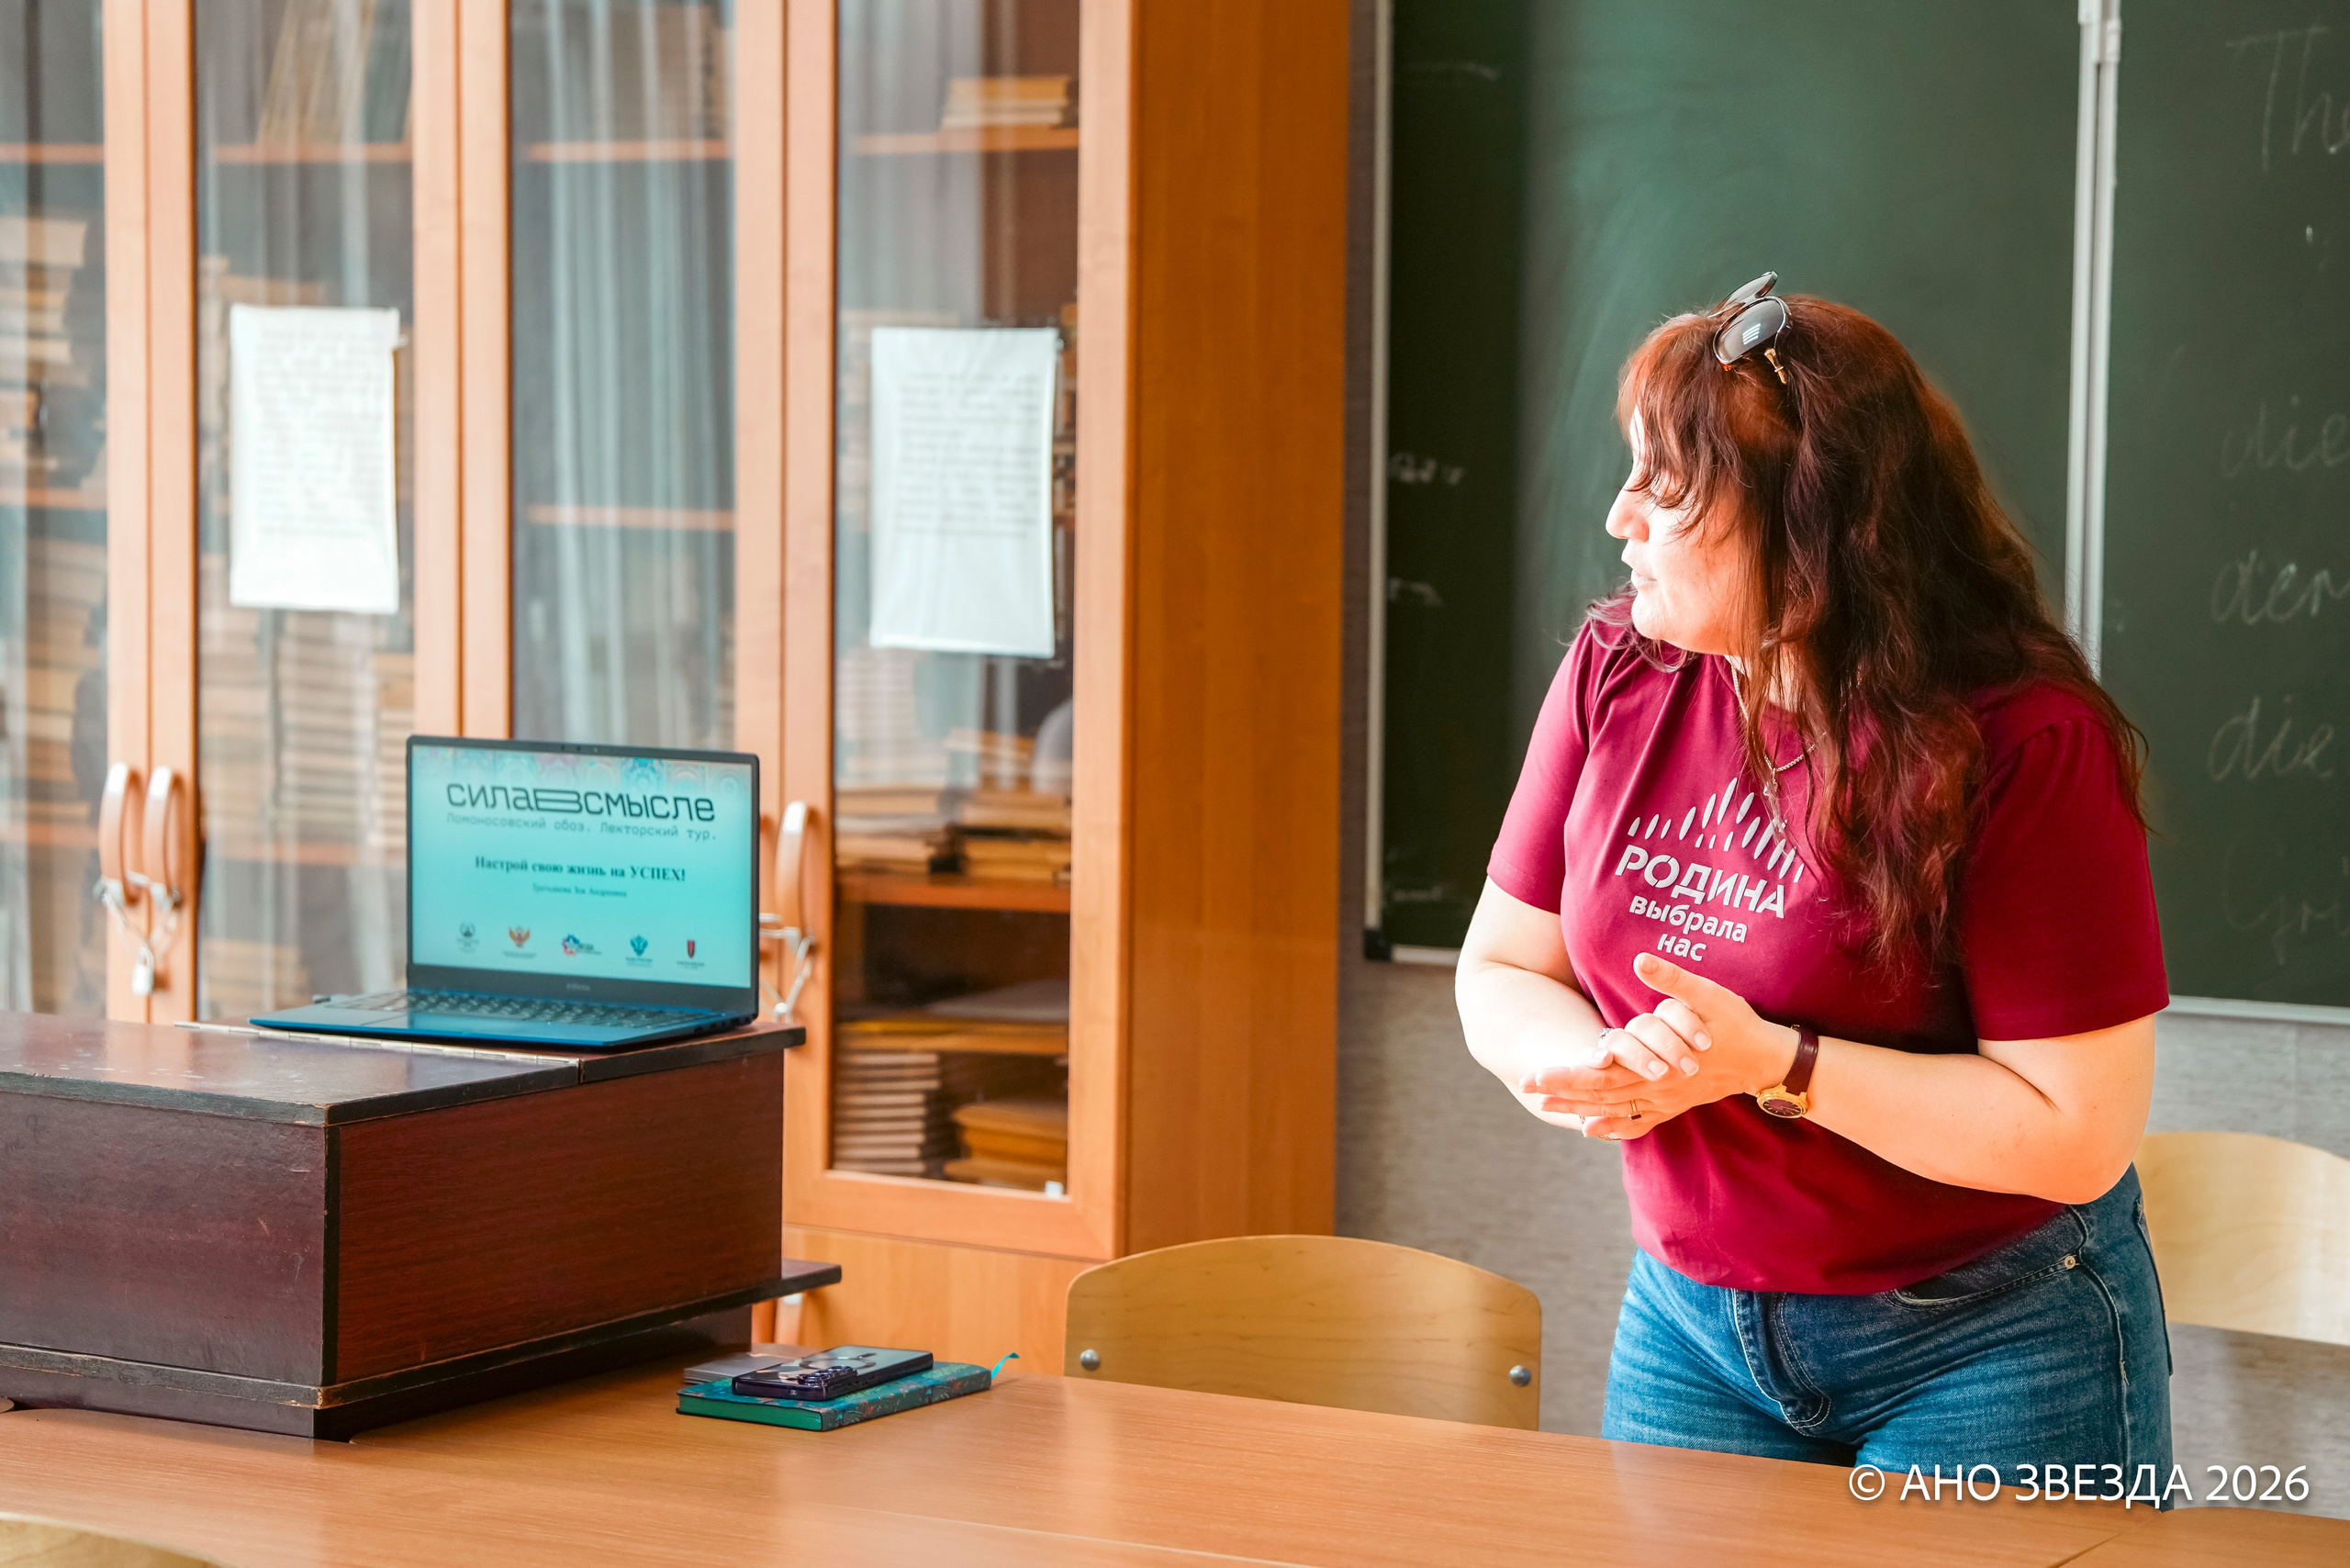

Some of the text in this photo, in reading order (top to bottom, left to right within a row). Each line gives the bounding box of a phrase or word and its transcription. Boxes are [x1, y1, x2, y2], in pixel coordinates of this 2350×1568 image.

[687, 828, 717, 842] тур.
[475, 855, 686, 882] Настрой свою жизнь на УСПЕХ!
[1615, 844, 1785, 919] РОДИНА
[1628, 894, 1748, 944] выбрала
[1656, 933, 1707, 962] нас
